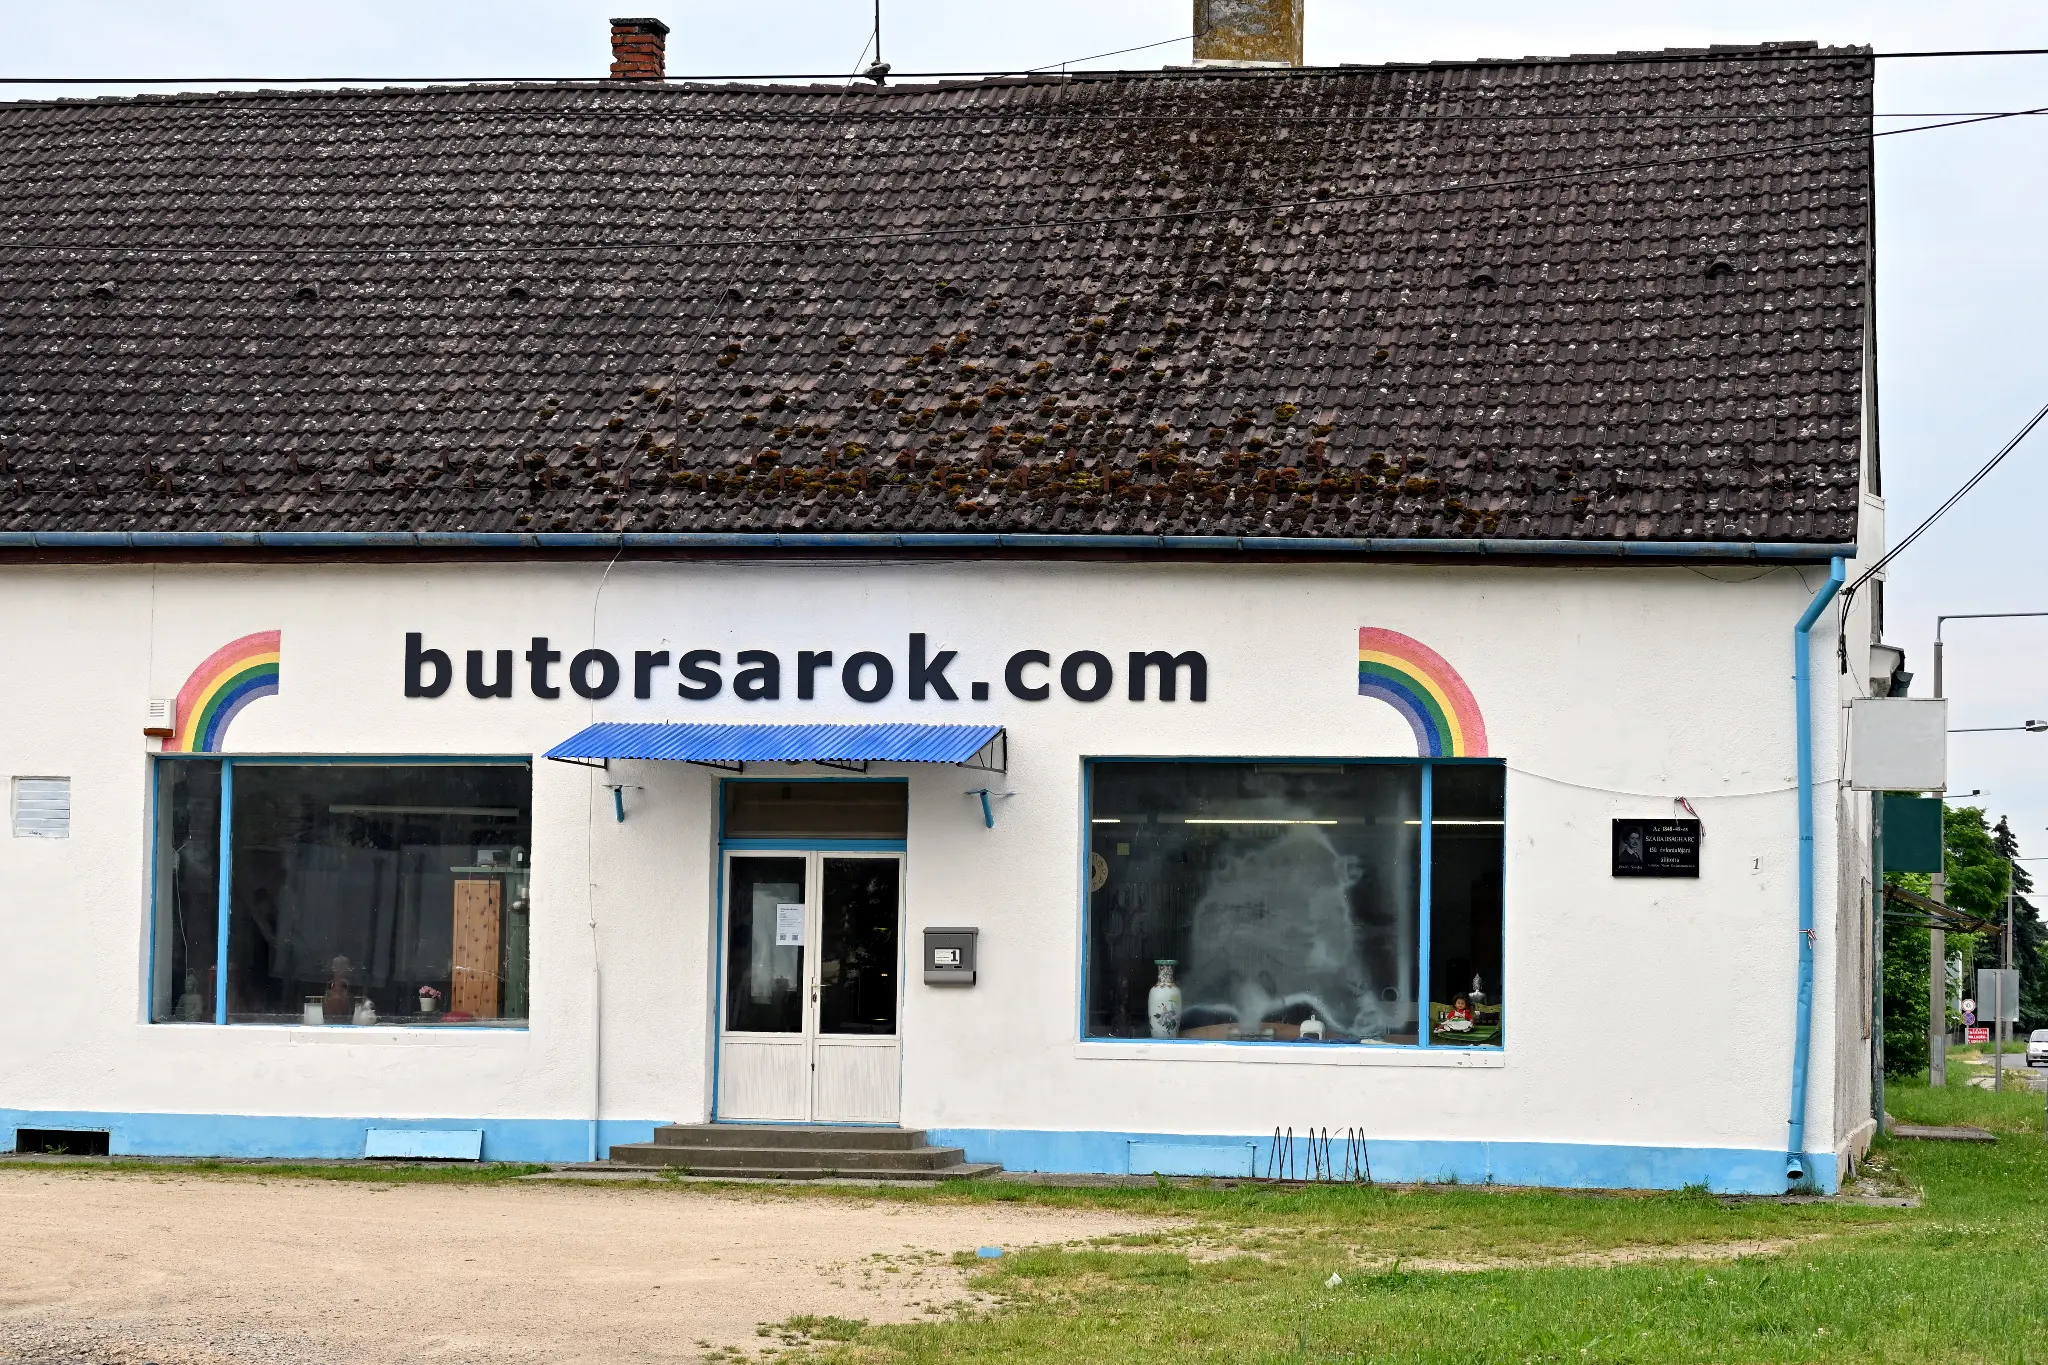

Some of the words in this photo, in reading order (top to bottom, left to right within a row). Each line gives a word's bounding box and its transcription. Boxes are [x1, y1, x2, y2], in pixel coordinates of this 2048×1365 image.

[404, 632, 1208, 702] butorsarok.com
[1753, 858, 1760, 870] 1
[951, 949, 959, 962] 1
